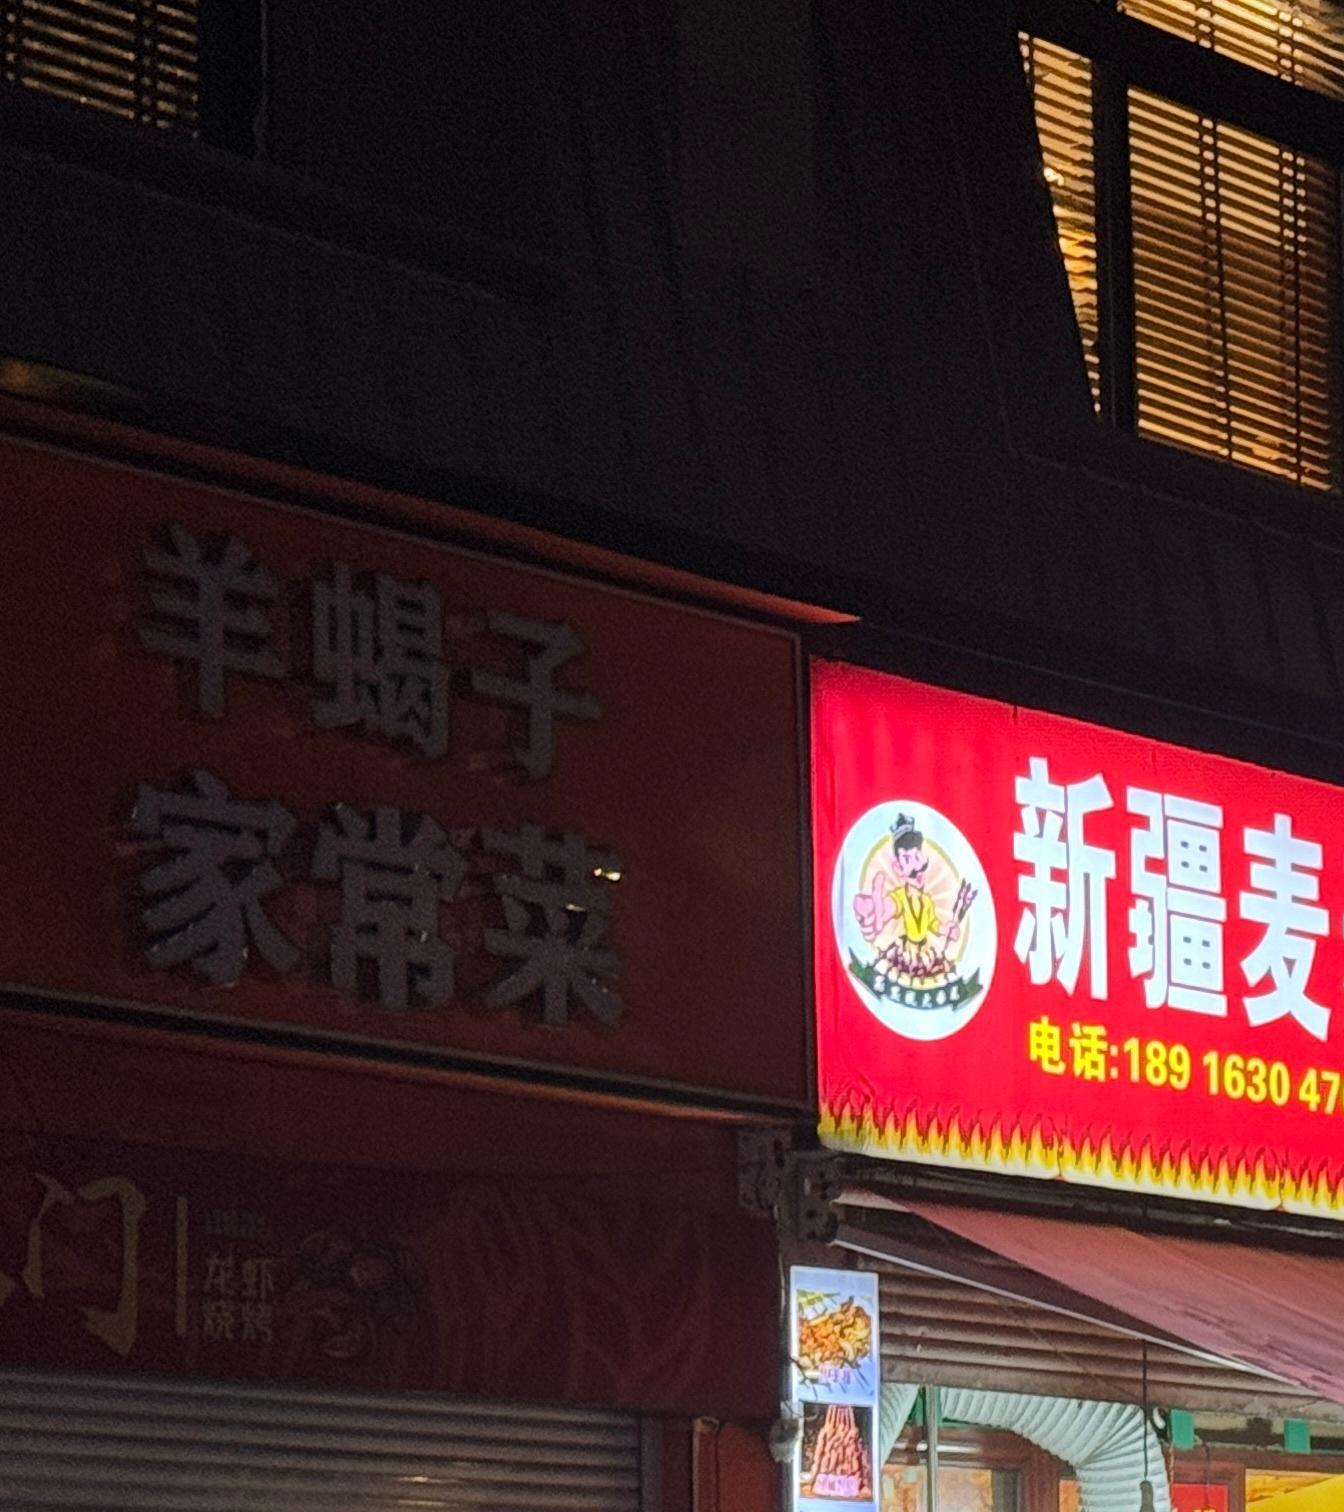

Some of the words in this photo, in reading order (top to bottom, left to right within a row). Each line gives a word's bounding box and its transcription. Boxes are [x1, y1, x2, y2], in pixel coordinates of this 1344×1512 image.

[134, 522, 601, 780] 羊蝎子
[130, 768, 625, 1031] 家常菜
[1202, 1051, 1290, 1107] 1630
